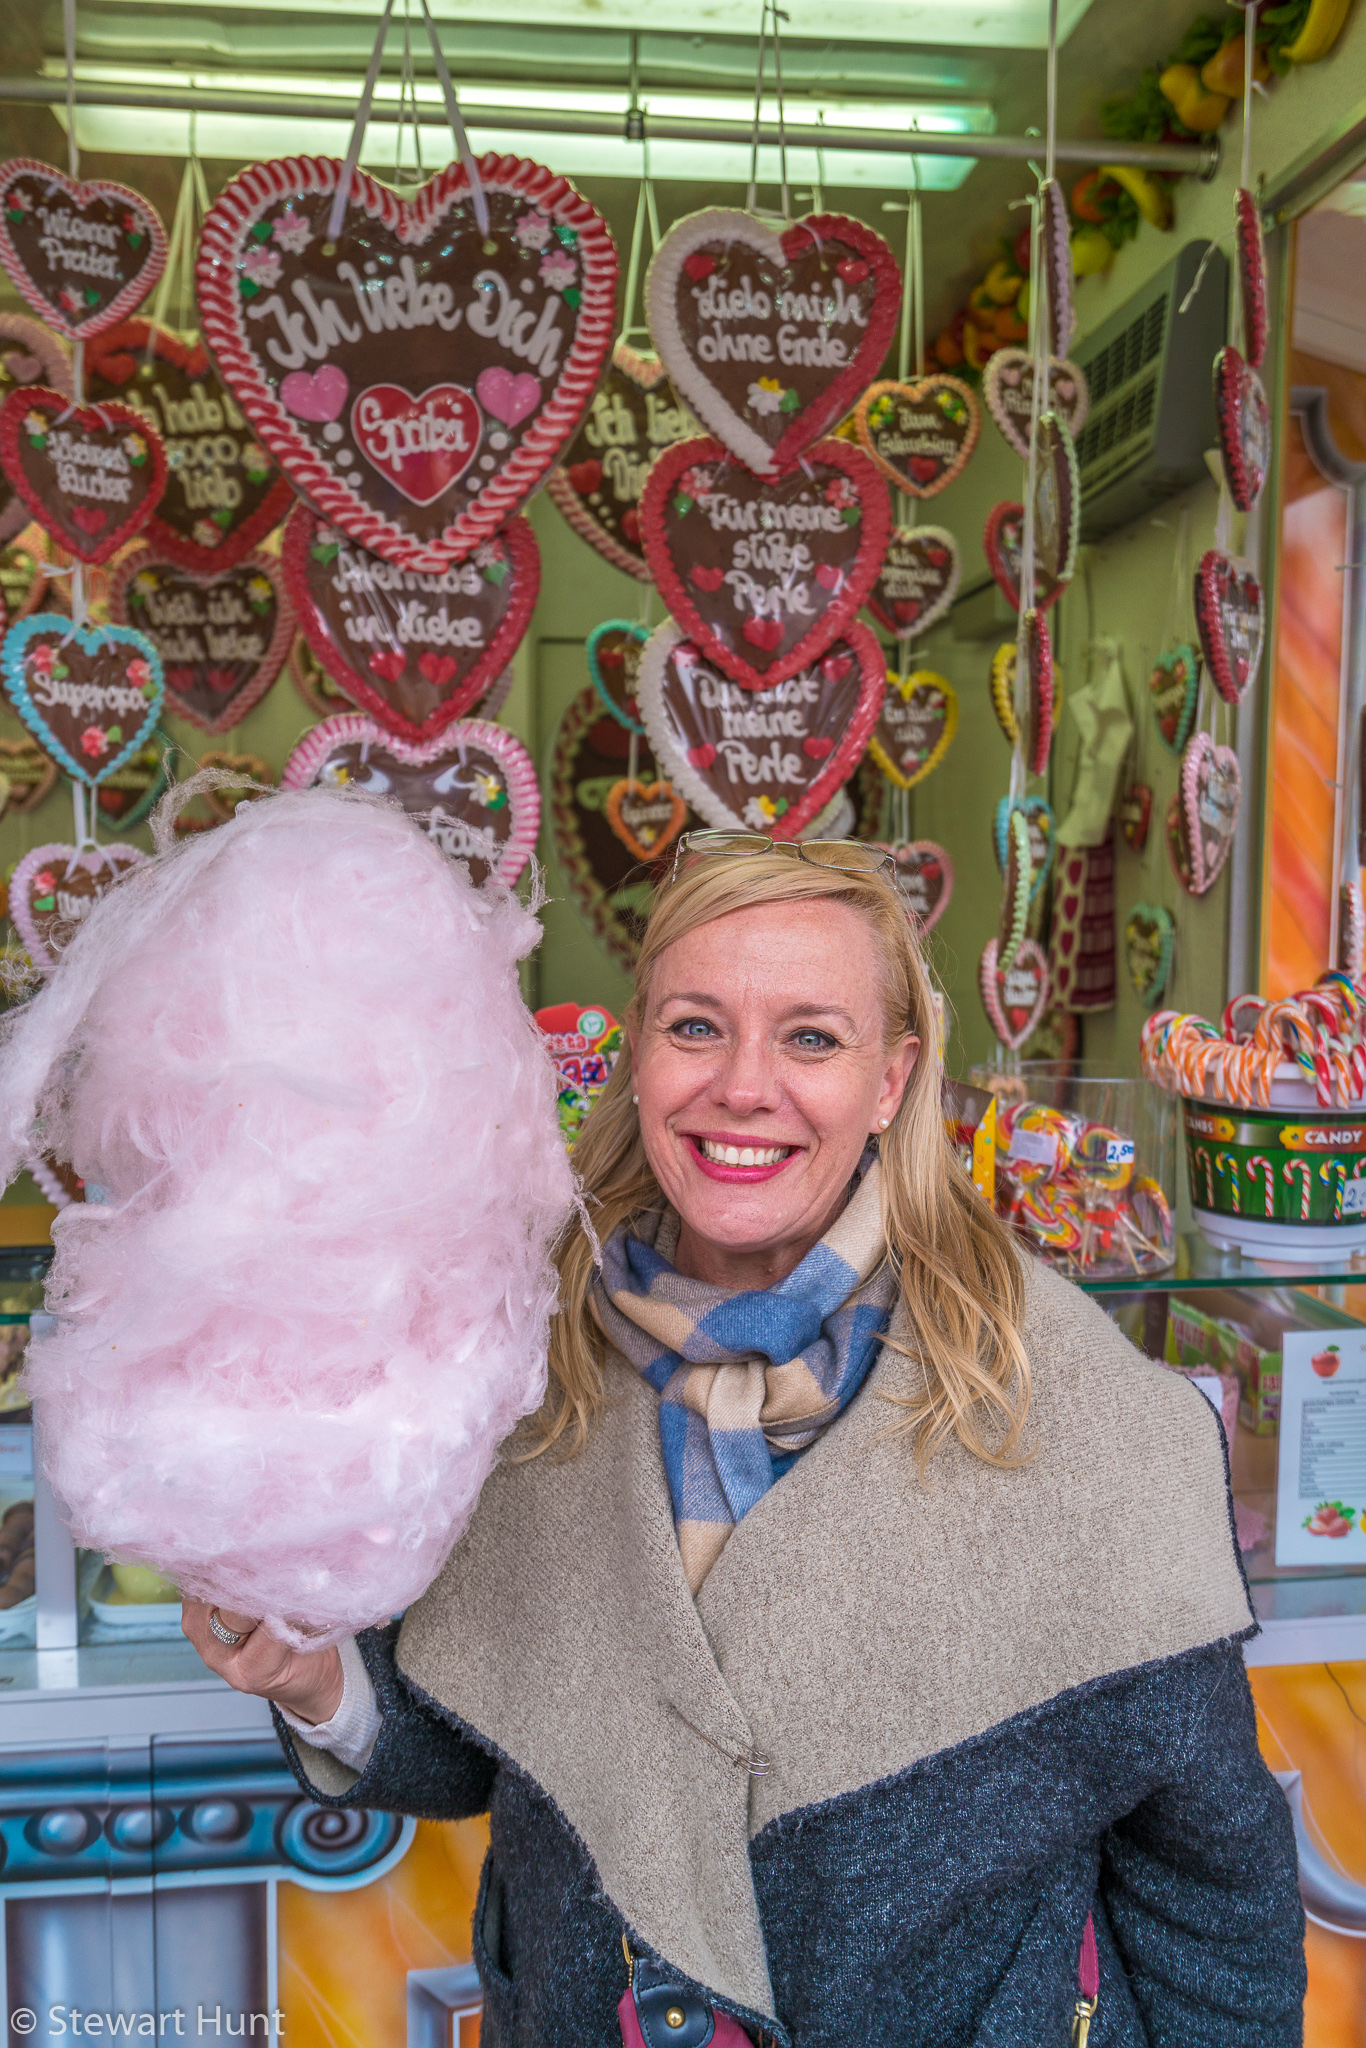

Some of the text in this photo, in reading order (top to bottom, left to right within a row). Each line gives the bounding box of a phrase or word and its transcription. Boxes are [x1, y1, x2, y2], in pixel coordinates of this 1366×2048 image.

[38, 238, 119, 279] Prater
[248, 256, 566, 377] Ich liebe Dich
[779, 279, 867, 327] mich
[698, 321, 853, 367] ohne Ende
[761, 492, 848, 532] meine
[724, 570, 818, 615] Perle
[722, 706, 808, 740] meine
[716, 739, 806, 784] Perle
[1304, 1130, 1362, 1145] CANDY
